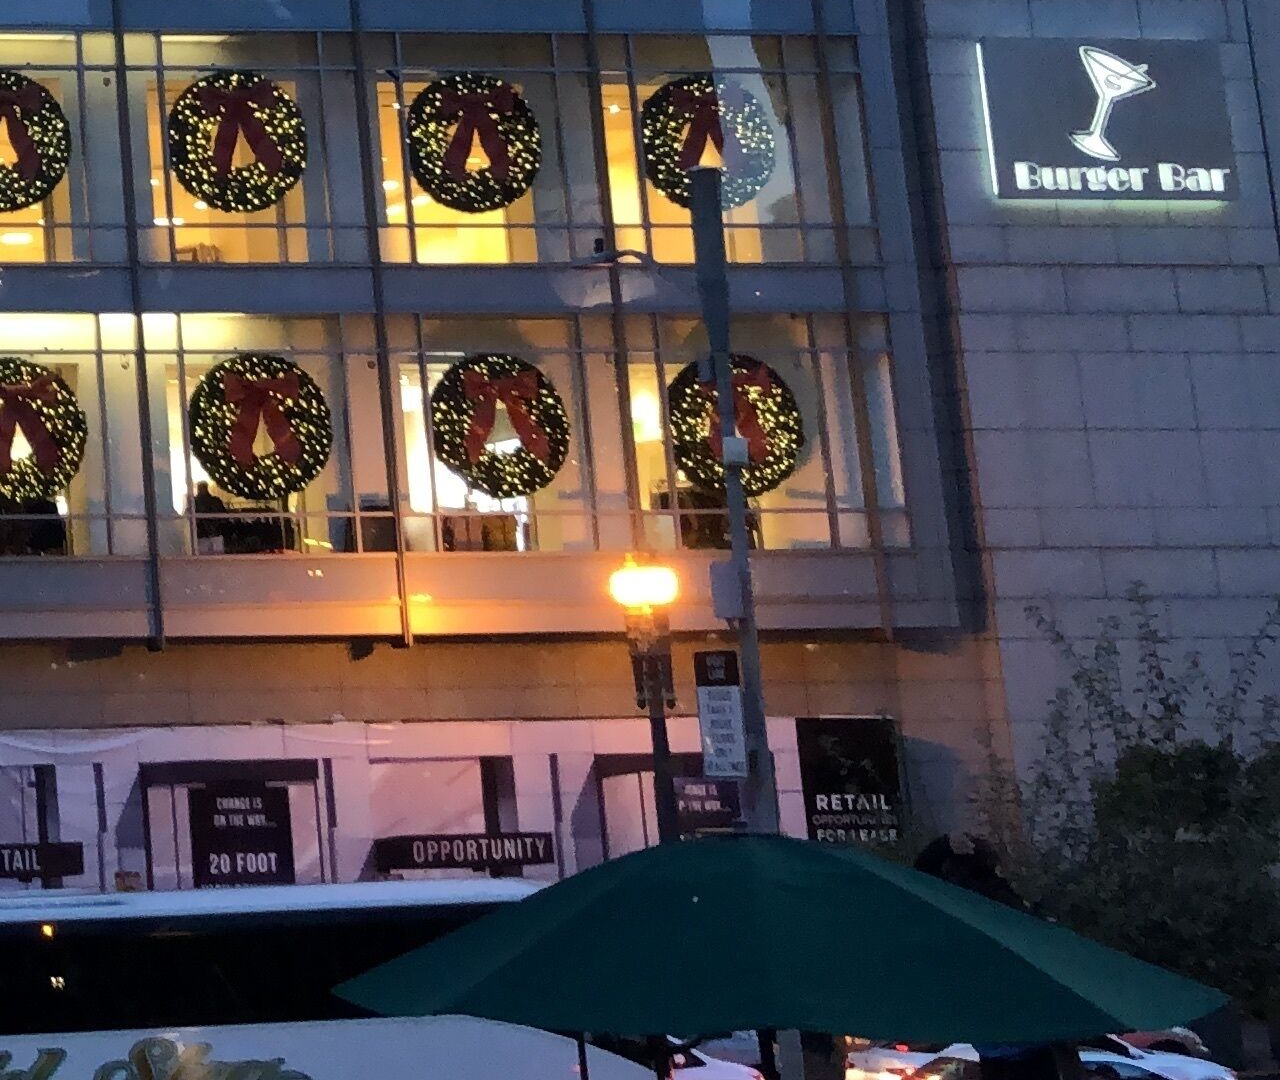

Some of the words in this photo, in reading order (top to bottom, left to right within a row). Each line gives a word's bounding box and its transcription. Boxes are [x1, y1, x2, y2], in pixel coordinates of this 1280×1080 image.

[1013, 161, 1150, 192] Burger
[1157, 162, 1231, 192] Bar
[816, 793, 891, 811] RETAIL
[209, 852, 232, 875] 20
[236, 851, 278, 874] FOOT
[412, 837, 547, 864] OPPORTUNITY
